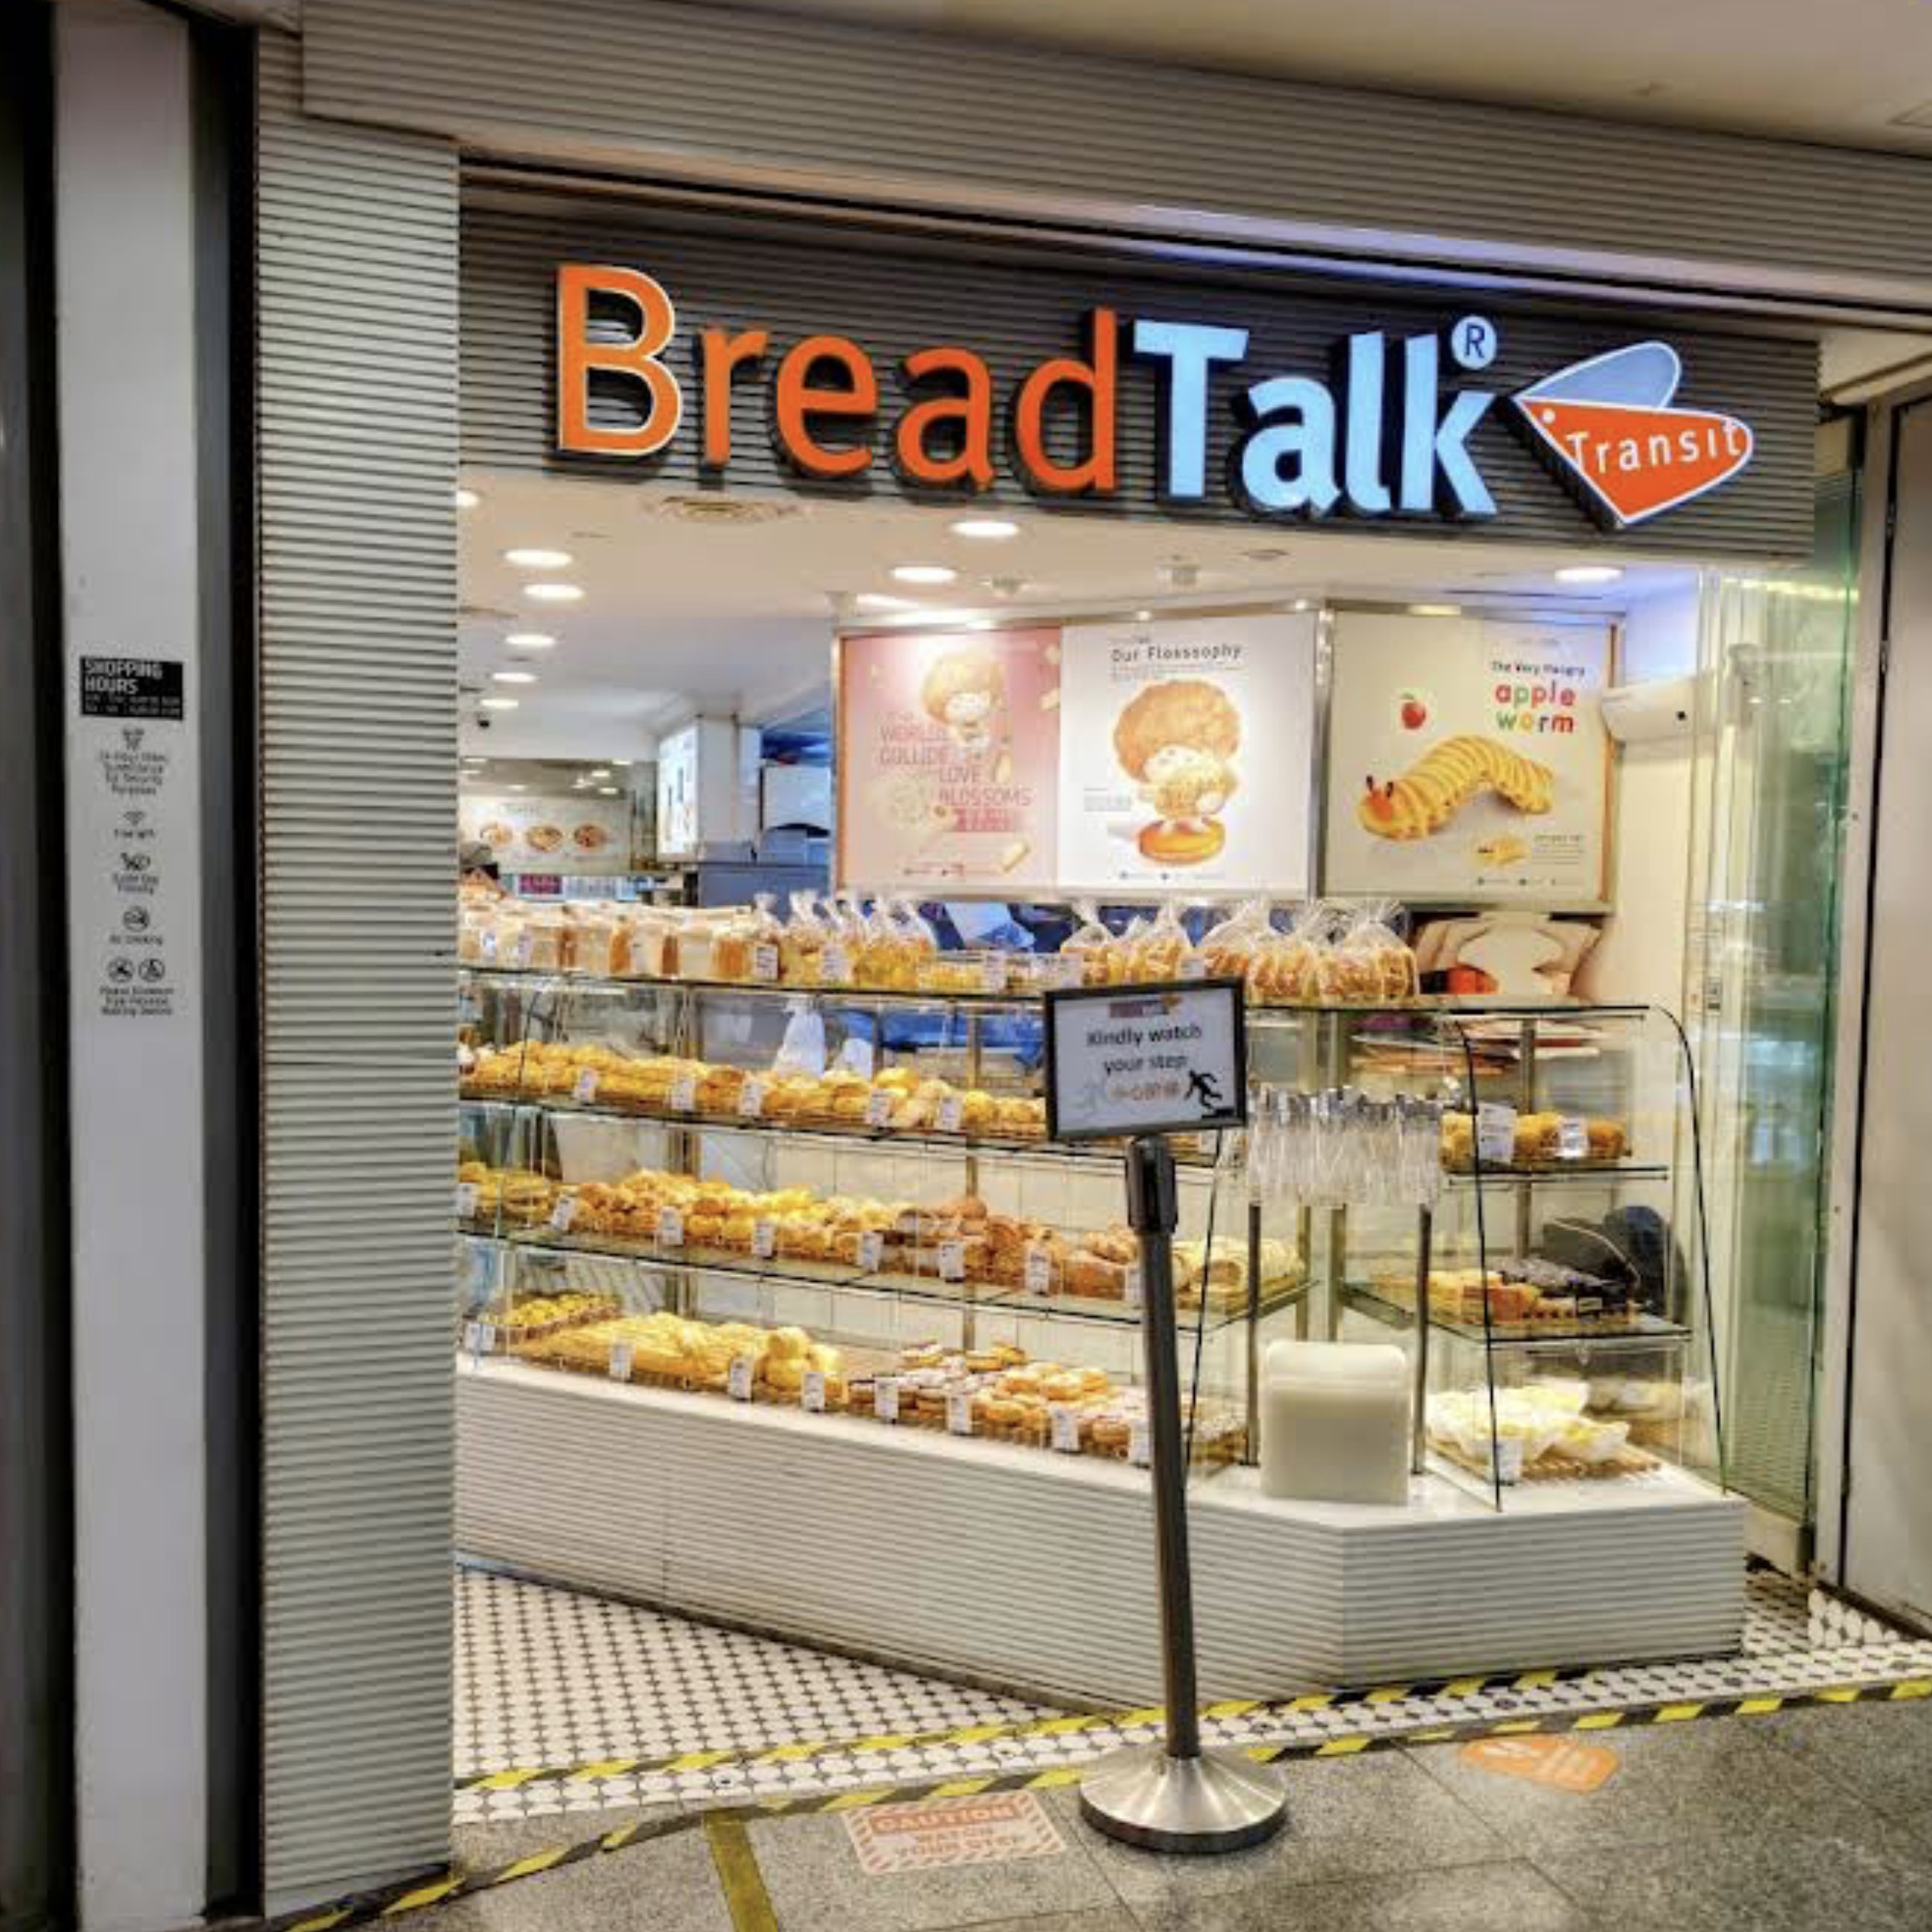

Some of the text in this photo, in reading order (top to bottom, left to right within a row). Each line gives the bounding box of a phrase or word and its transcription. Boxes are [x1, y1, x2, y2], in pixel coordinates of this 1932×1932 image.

[1565, 417, 1743, 476] Transit
[1111, 648, 1139, 663] Our
[1491, 660, 1511, 673] The
[85, 658, 163, 680] SHOPPING
[85, 677, 139, 695] HOURS
[1495, 679, 1576, 709] apple
[1495, 711, 1573, 733] worm
[938, 765, 982, 783] LOVE
[1087, 1023, 1202, 1047] Kindly watch
[1103, 1054, 1188, 1077] your step
[876, 1805, 1015, 1832] CAUTION
